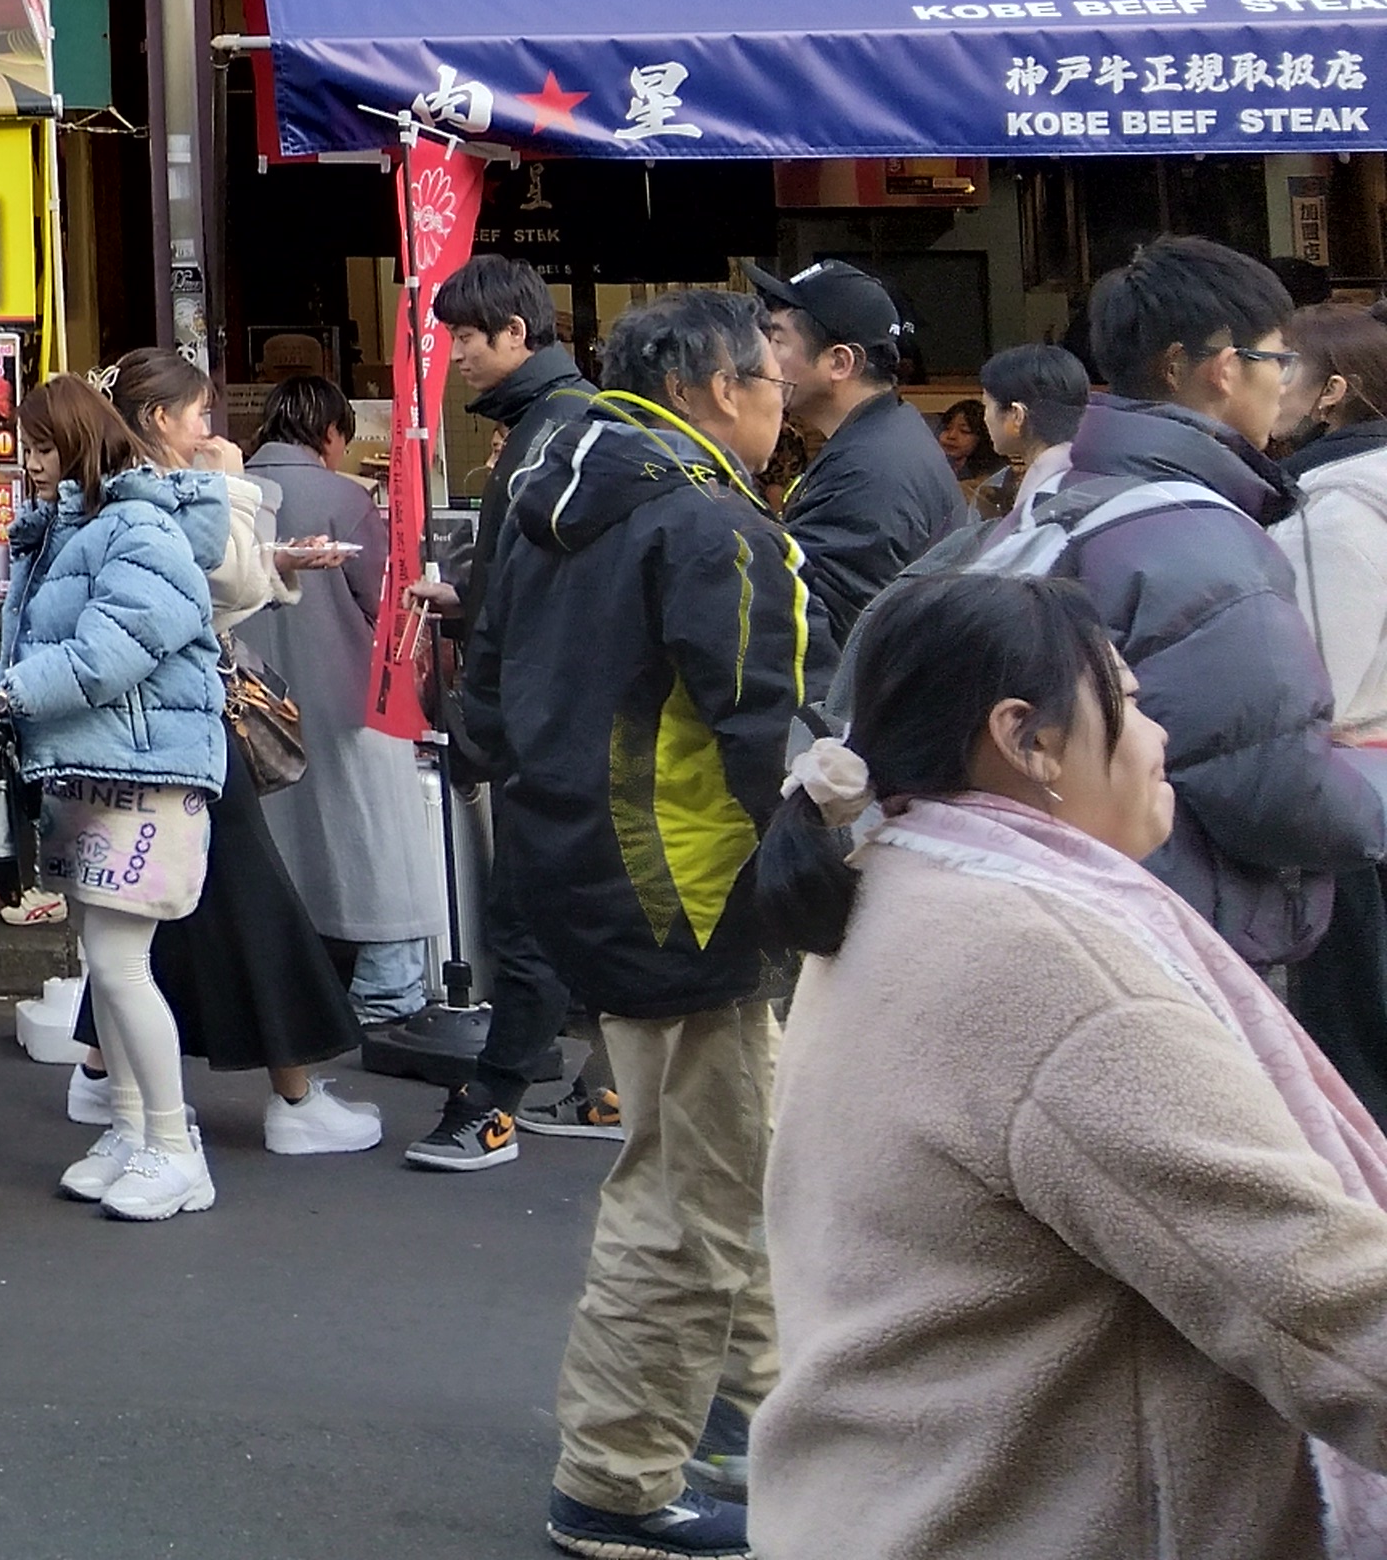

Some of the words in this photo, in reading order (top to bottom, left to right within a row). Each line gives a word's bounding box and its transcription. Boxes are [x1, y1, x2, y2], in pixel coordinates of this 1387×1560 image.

[911, 1, 1061, 21] KOBE
[1006, 50, 1367, 96] 神戸牛正規取扱店
[412, 66, 493, 133] 肉
[614, 61, 702, 140] 星
[1007, 111, 1110, 137] KOBE
[1122, 109, 1218, 134] BEEF
[1240, 107, 1369, 133] STEAK
[123, 822, 156, 884] COCO
